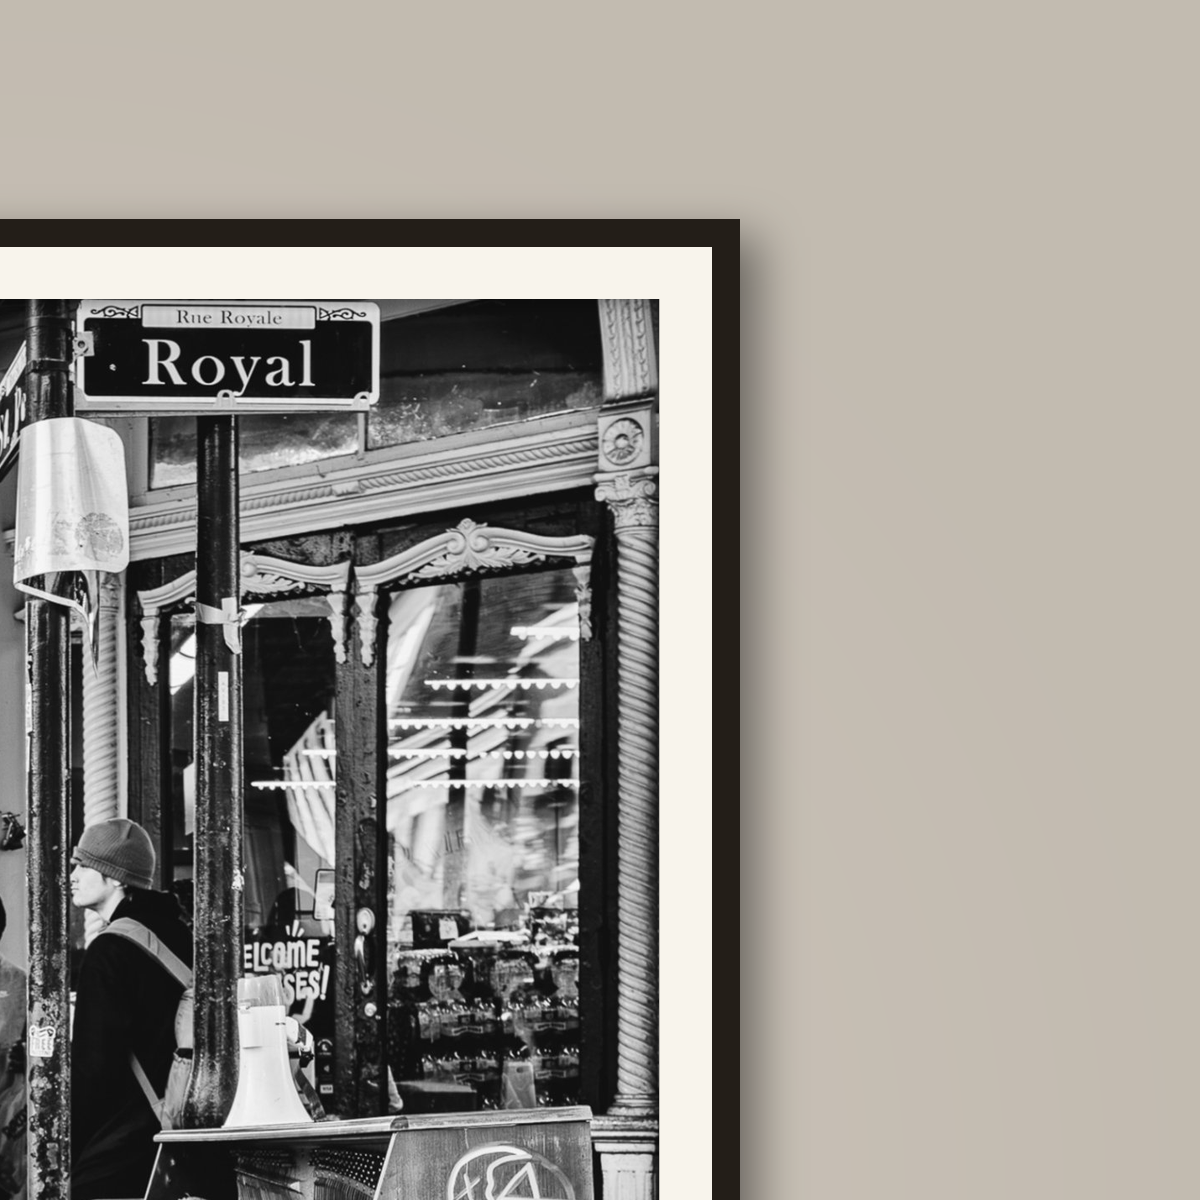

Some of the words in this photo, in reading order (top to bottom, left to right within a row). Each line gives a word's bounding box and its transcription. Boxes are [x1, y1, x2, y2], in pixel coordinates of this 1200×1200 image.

[176, 309, 212, 325] Rue
[220, 309, 283, 328] Royale
[141, 339, 316, 397] Royal
[243, 938, 321, 973] ELCOME
[278, 964, 331, 1007] SES!
